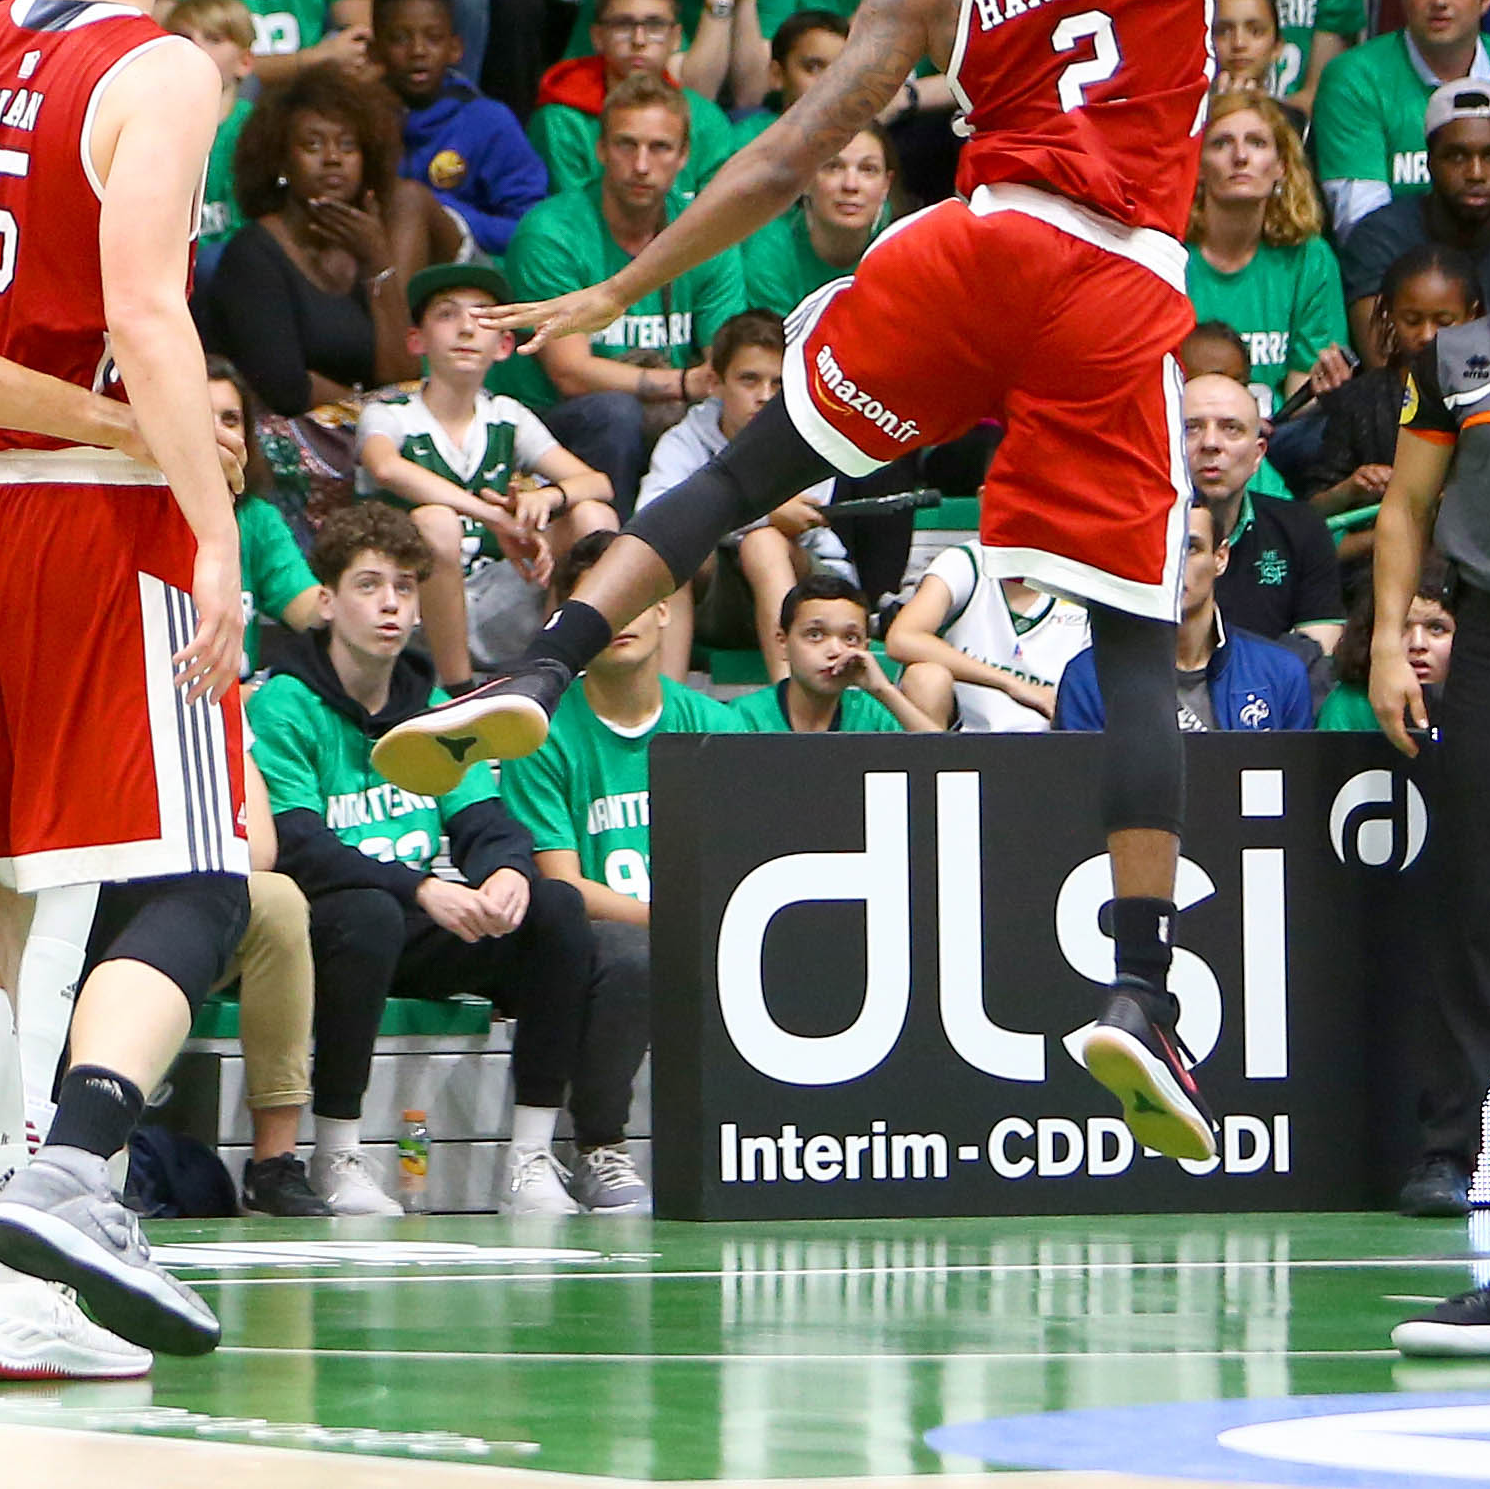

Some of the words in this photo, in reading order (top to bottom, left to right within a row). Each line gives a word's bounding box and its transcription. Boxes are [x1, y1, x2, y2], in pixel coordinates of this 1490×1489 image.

[1050, 9, 1122, 114] 2
[815, 344, 920, 444] amazon.fr
[716, 768, 1291, 1088] dlsi
